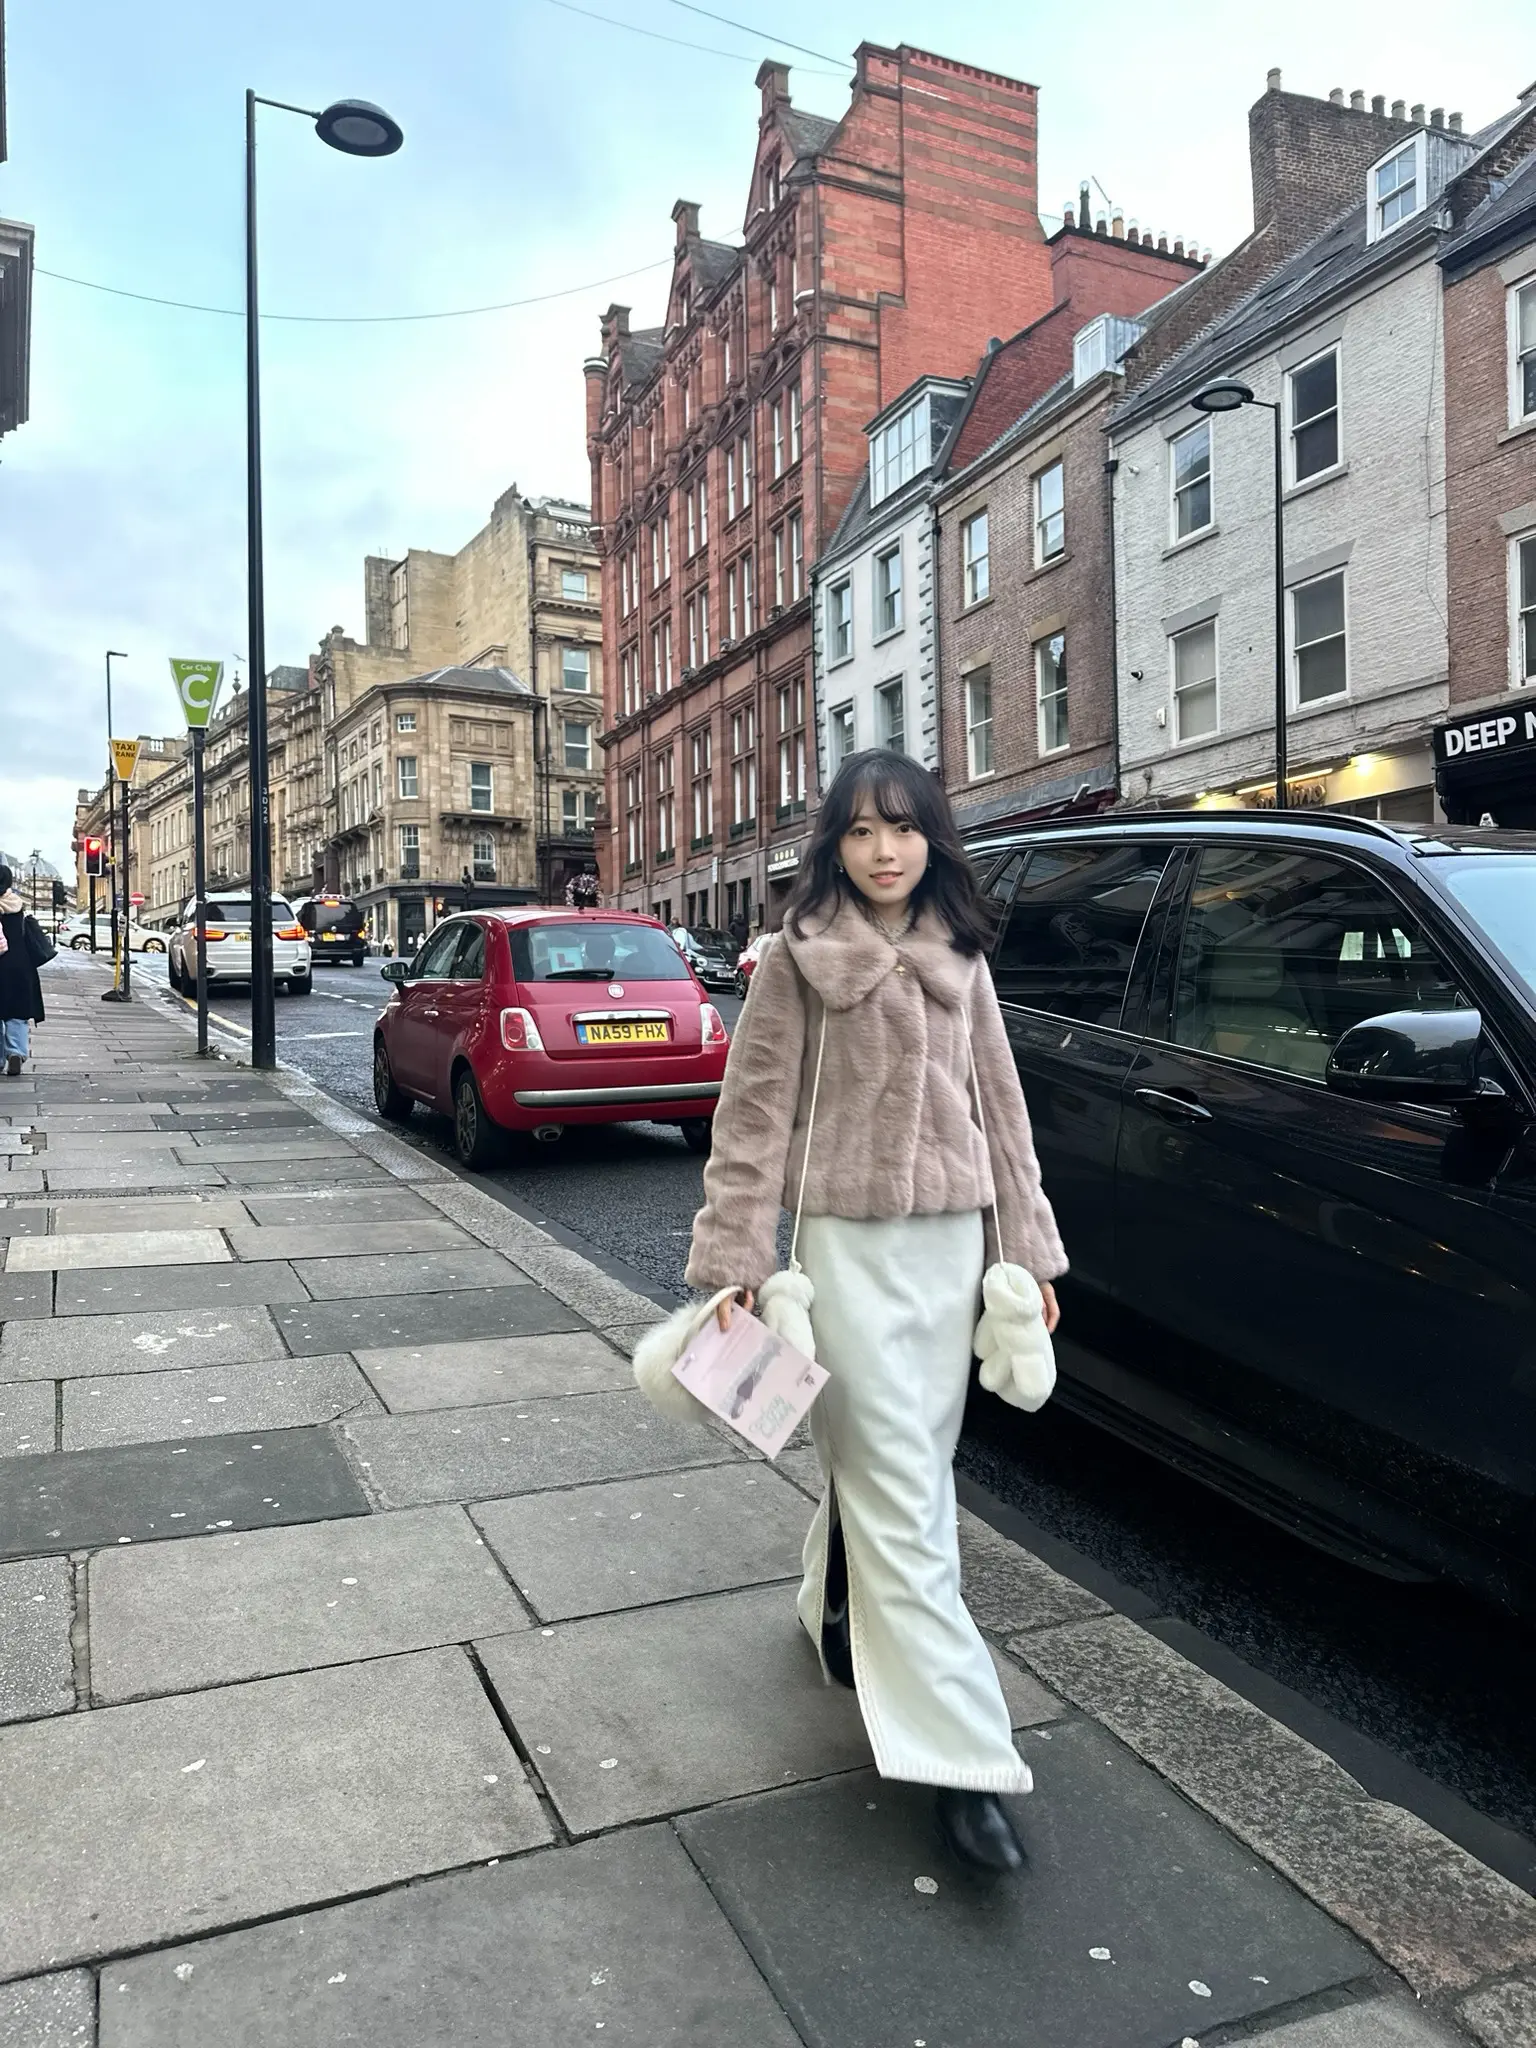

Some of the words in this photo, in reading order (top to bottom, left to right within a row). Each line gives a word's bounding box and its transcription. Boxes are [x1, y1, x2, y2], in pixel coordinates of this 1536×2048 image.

[180, 663, 193, 671] Car
[195, 664, 212, 672] Club
[182, 674, 210, 708] C
[1444, 716, 1517, 757] DEEP
[115, 743, 136, 751] TAXI
[557, 953, 575, 968] L
[590, 1025, 632, 1041] NA59
[635, 1024, 665, 1039] FHX
